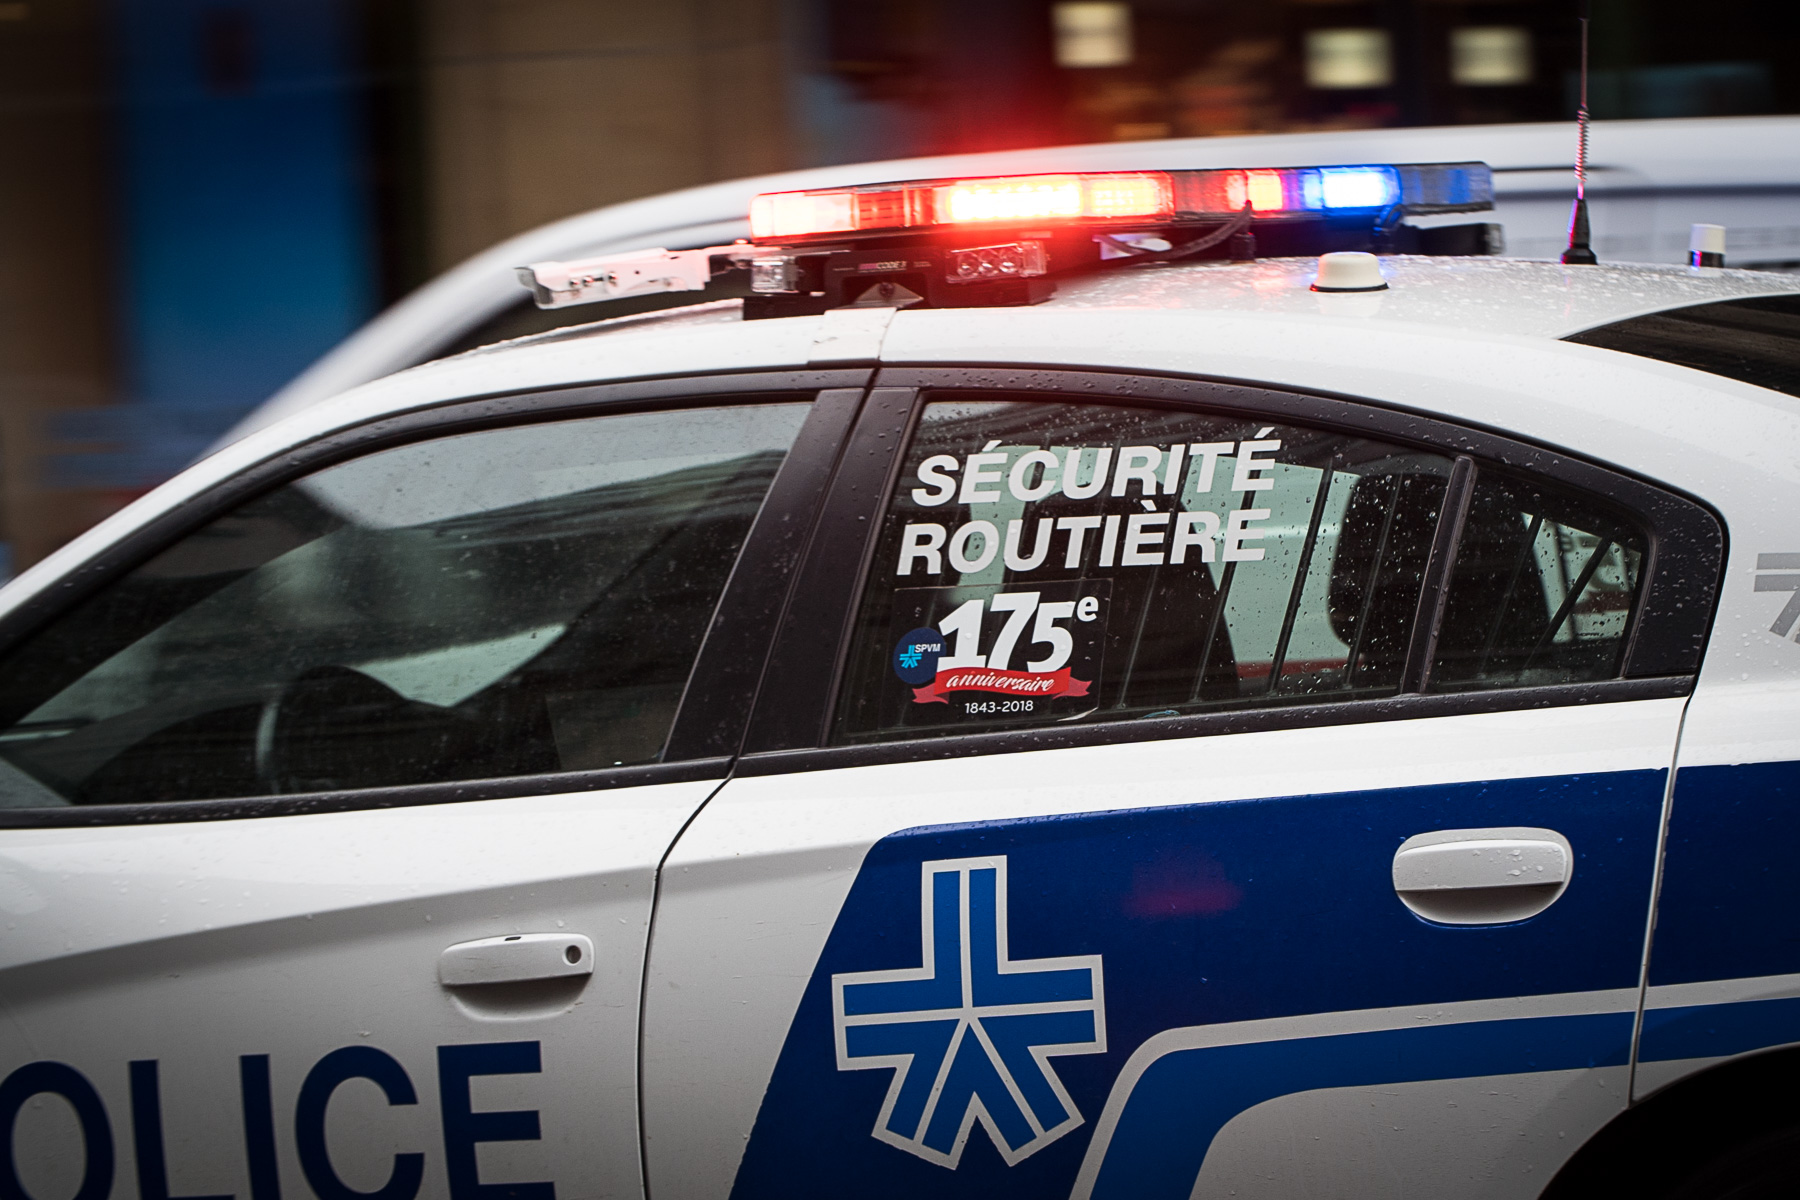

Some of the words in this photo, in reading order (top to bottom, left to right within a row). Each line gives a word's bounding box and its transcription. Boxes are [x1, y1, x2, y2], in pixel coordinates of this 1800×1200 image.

[911, 427, 1281, 506] SÉCURITÉ
[896, 500, 1271, 575] ROUTIÈRE
[914, 643, 941, 653] SPVM
[946, 671, 1055, 692] anniversaire
[965, 700, 1034, 713] 1843-2018
